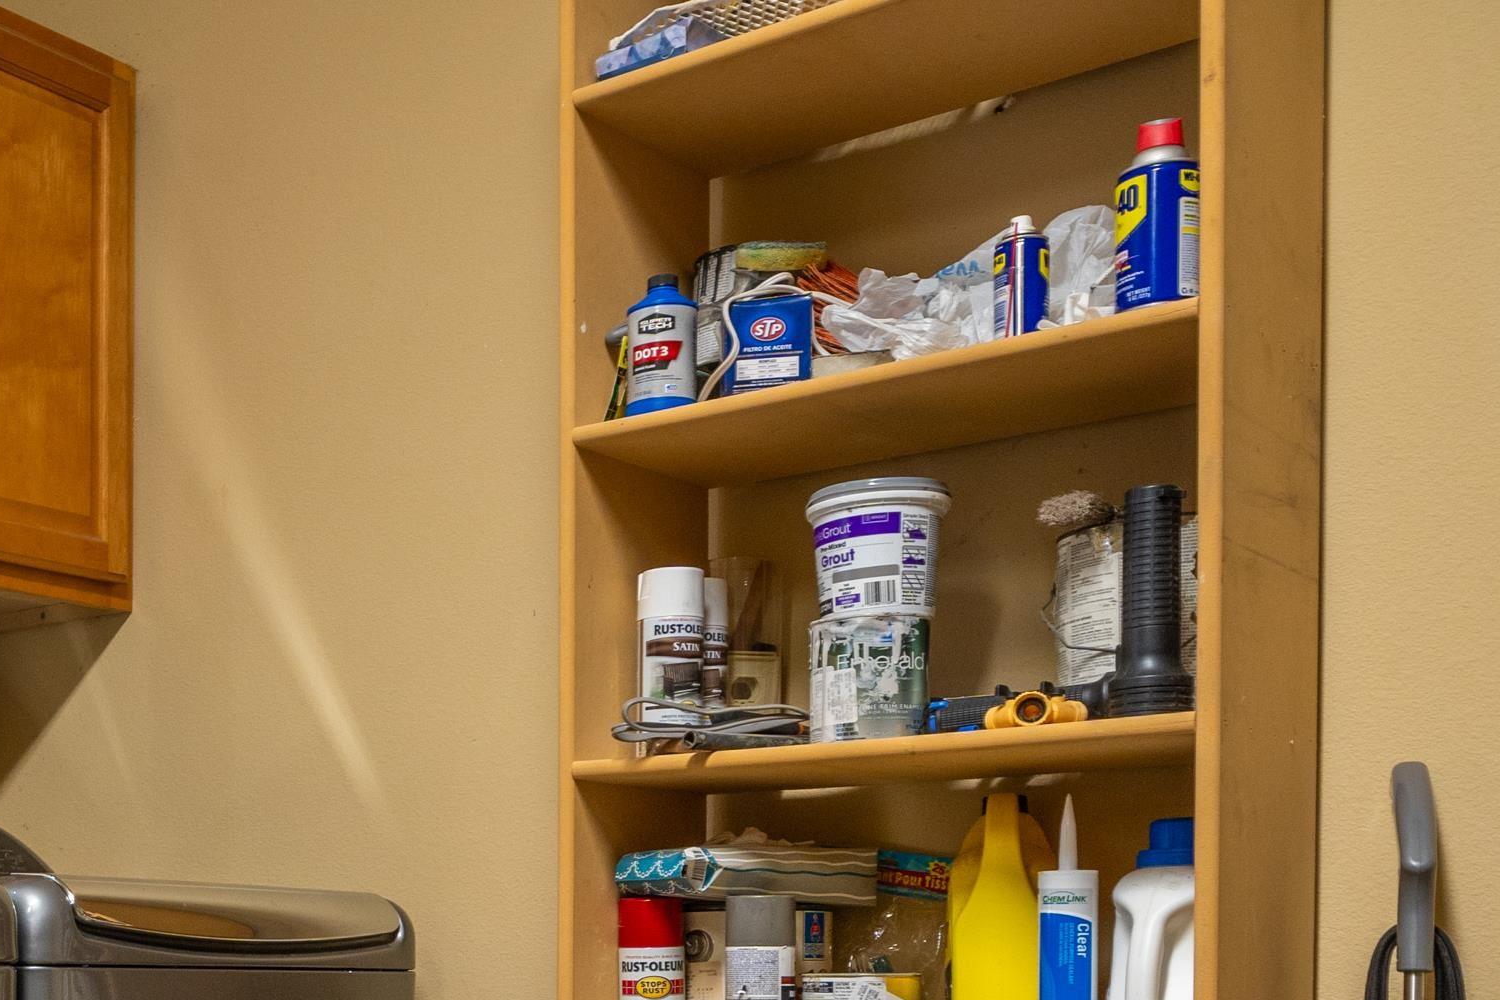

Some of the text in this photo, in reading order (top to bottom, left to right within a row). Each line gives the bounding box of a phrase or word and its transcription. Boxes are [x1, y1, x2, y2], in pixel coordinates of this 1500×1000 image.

[640, 322, 672, 331] TECH
[754, 319, 783, 338] STP
[635, 345, 669, 361] DOT 3
[821, 548, 855, 568] Grout
[837, 650, 924, 670] Emeald
[895, 871, 922, 886] Pour
[1042, 894, 1088, 903] CHEM LINK
[1076, 923, 1090, 958] Clear
[622, 960, 684, 972] RUST-OLEUM
[641, 980, 667, 988] STOPS
